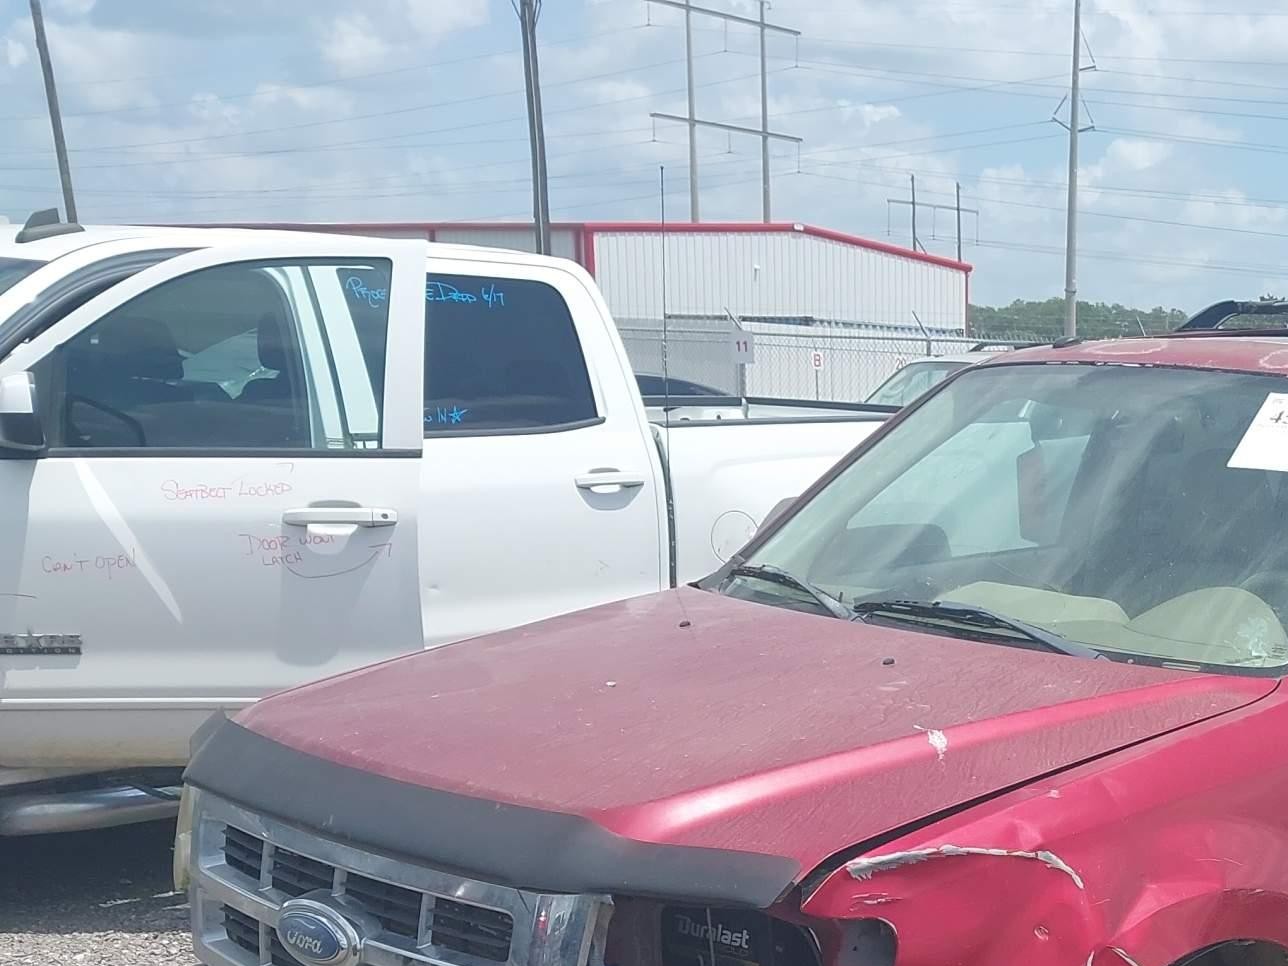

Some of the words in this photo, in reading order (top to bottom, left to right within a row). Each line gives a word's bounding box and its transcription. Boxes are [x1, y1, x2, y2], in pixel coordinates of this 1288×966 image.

[735, 341, 748, 353] 11
[233, 477, 293, 498] LOCKED
[238, 533, 290, 555] DOOR
[95, 547, 136, 581] OPEN
[262, 551, 303, 567] LATCH
[285, 919, 324, 954] Ford
[674, 914, 751, 949] Duralast
